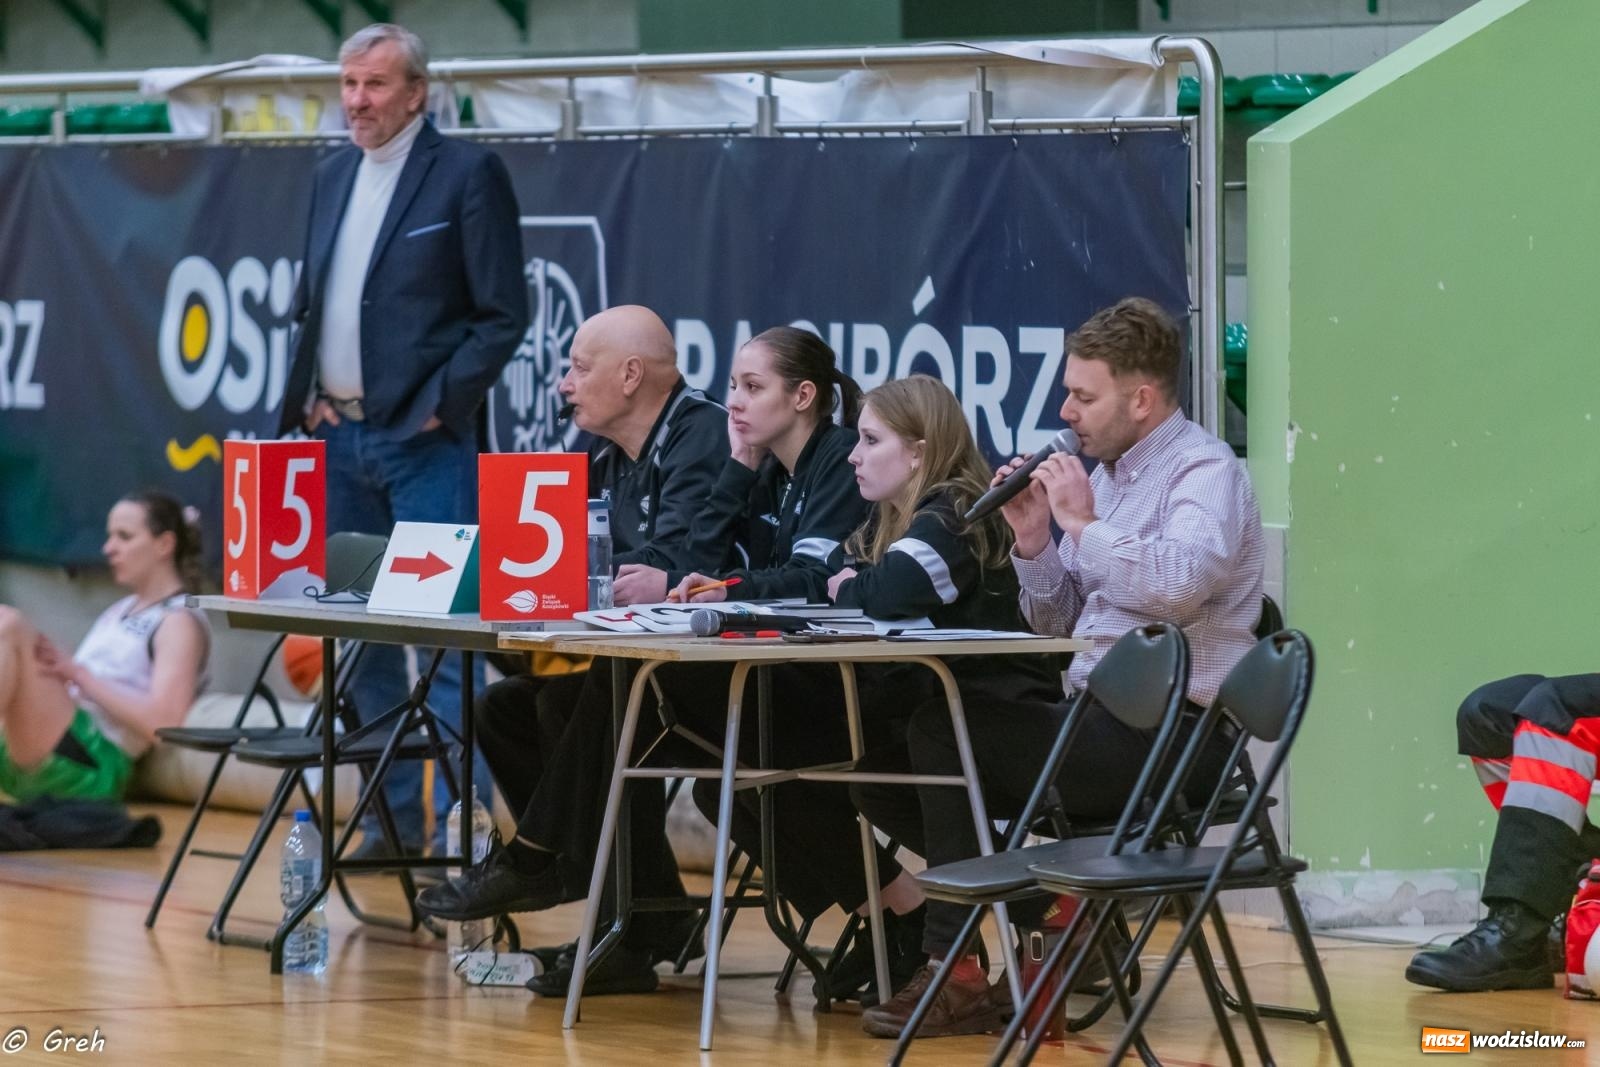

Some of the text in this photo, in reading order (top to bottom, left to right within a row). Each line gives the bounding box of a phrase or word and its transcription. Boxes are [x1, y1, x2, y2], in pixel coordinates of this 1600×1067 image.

[228, 458, 249, 559] 5
[270, 458, 316, 560] 5
[499, 471, 570, 578] 5
